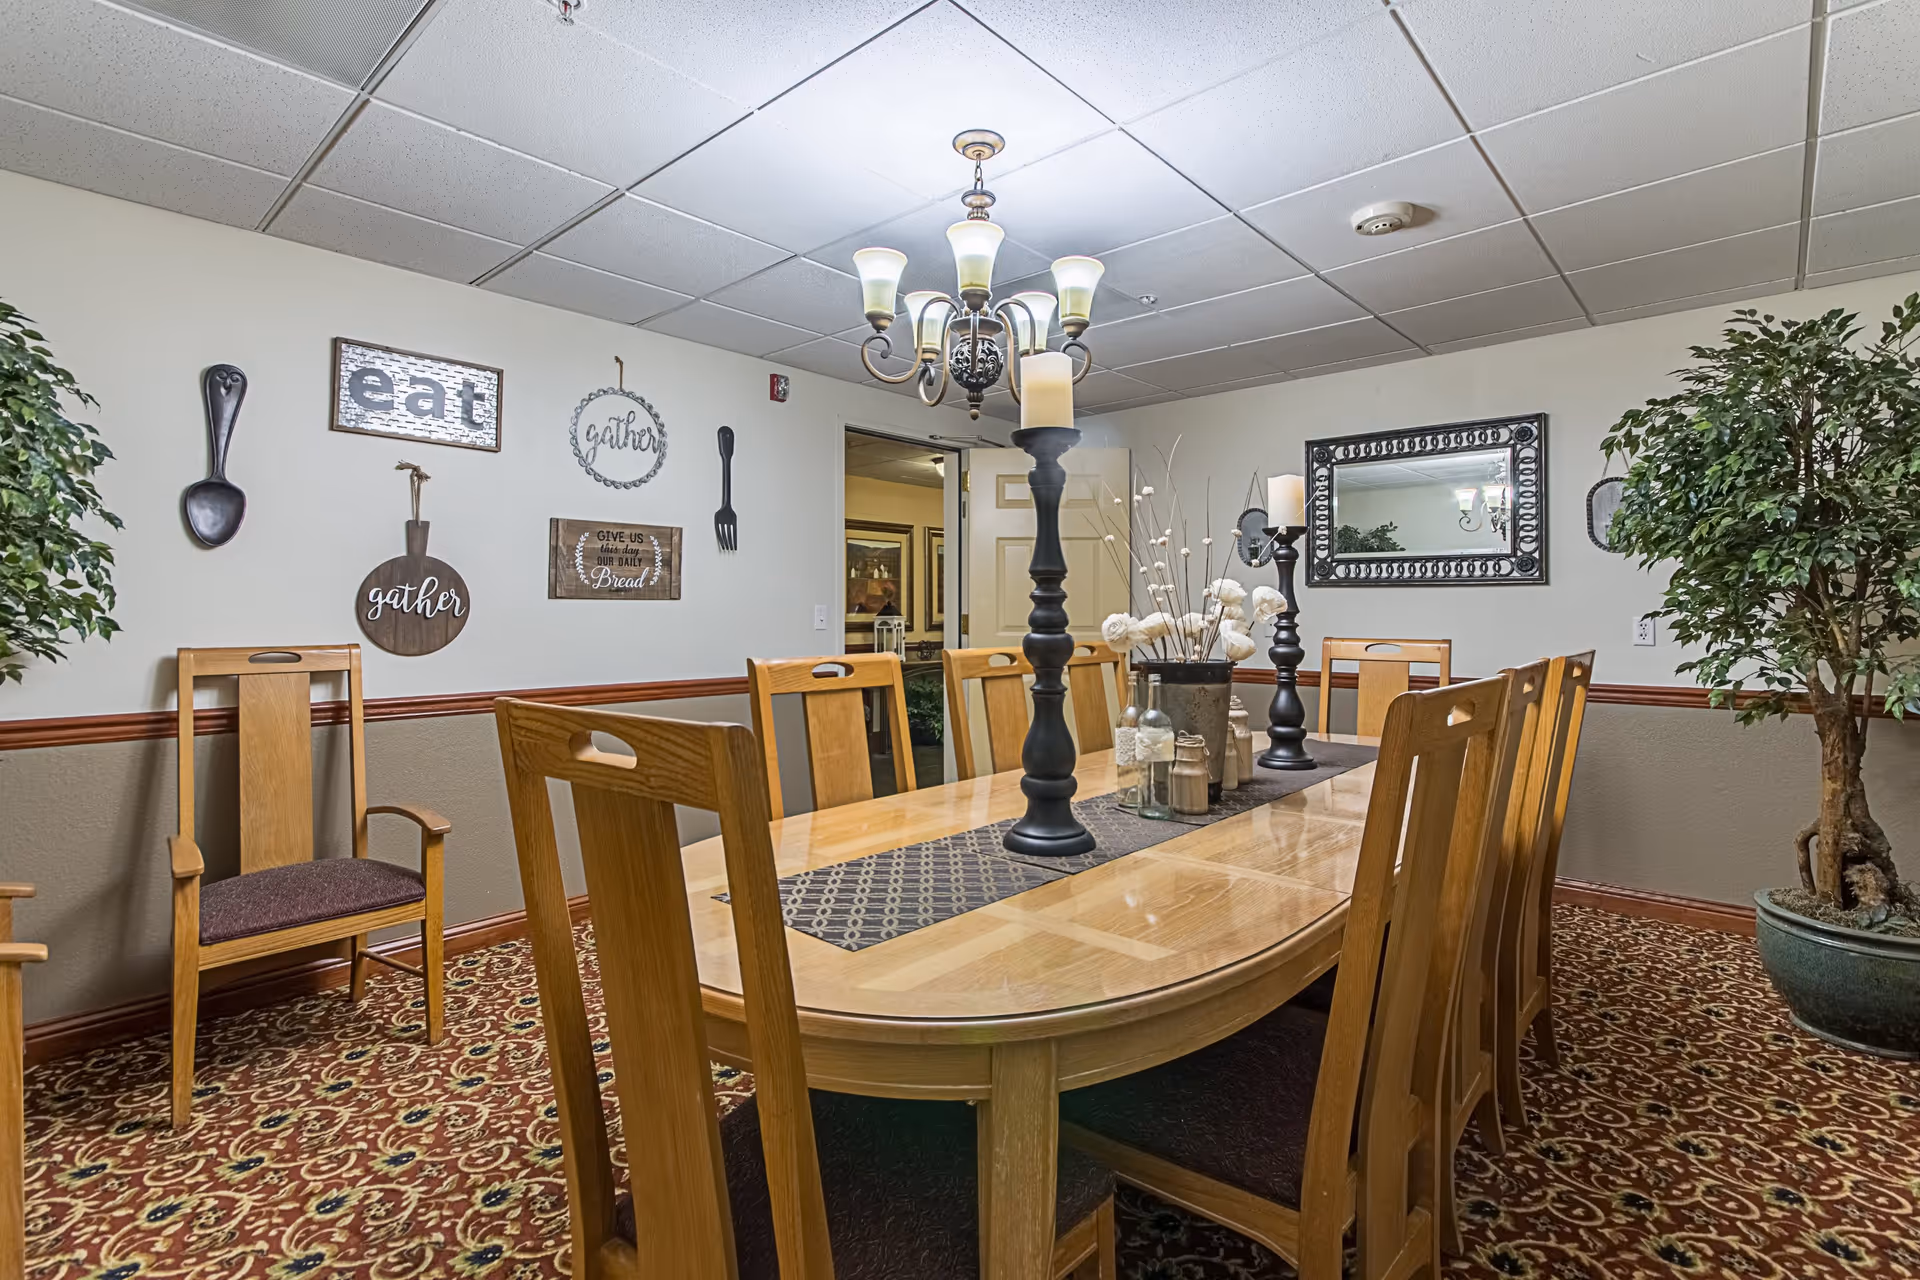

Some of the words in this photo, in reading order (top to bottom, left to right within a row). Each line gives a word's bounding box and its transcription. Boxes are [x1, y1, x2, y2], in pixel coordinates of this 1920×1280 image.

[350, 367, 486, 430] eat
[586, 410, 661, 466] gather
[597, 530, 625, 542] GIVE
[630, 532, 644, 544] US
[597, 556, 614, 566] OUR
[618, 557, 643, 567] DAILY
[600, 543, 618, 554] this
[622, 544, 640, 557] day
[591, 565, 650, 589] Bread
[367, 576, 467, 621] gather
